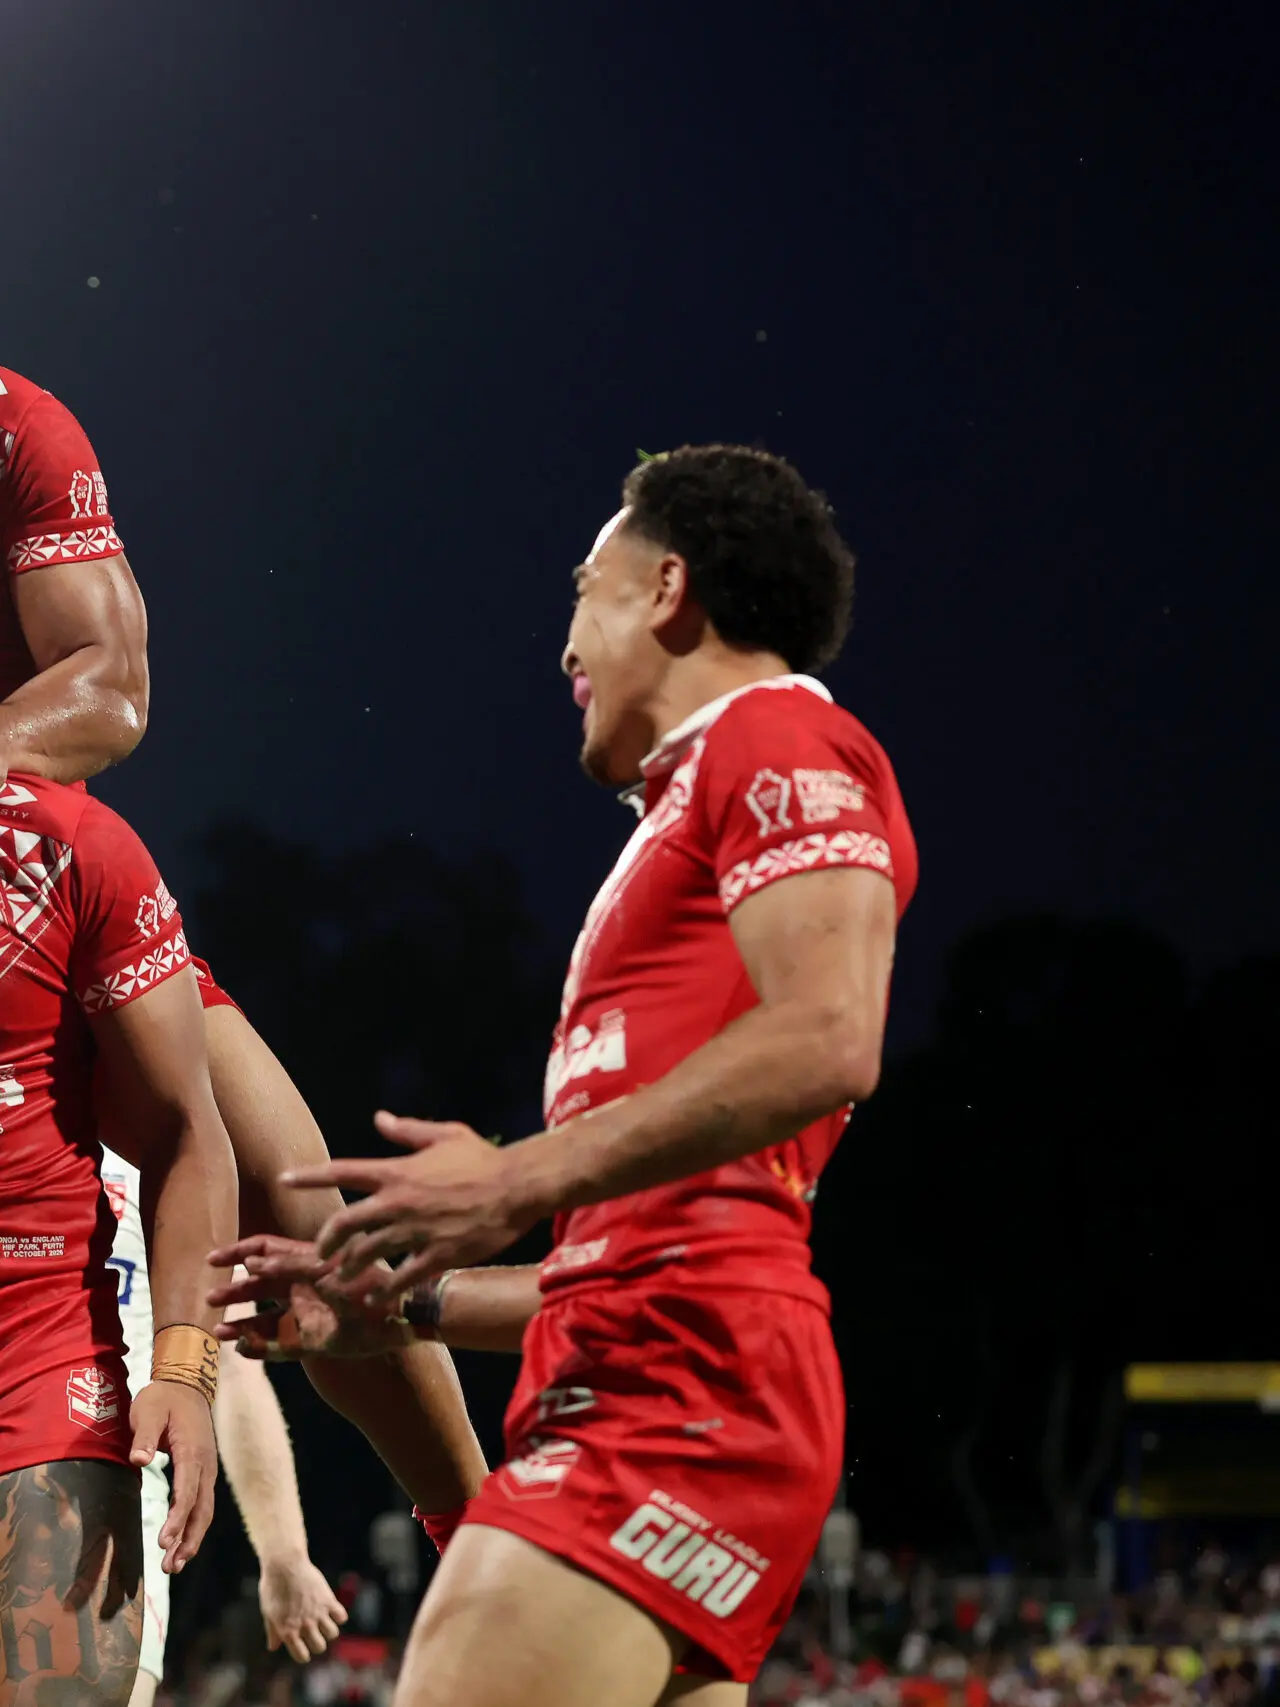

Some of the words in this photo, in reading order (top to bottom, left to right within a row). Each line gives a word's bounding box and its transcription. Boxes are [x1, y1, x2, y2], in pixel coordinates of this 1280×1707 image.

[32, 1235, 65, 1243] ENGLAND
[2, 1243, 16, 1251] HBF
[18, 1243, 40, 1251] PARK,
[42, 1242, 64, 1250] PERTH
[3, 1250, 10, 1258] 17
[13, 1250, 46, 1258] OCTOBER
[48, 1249, 64, 1257] 2026
[610, 1502, 761, 1618] GURU
